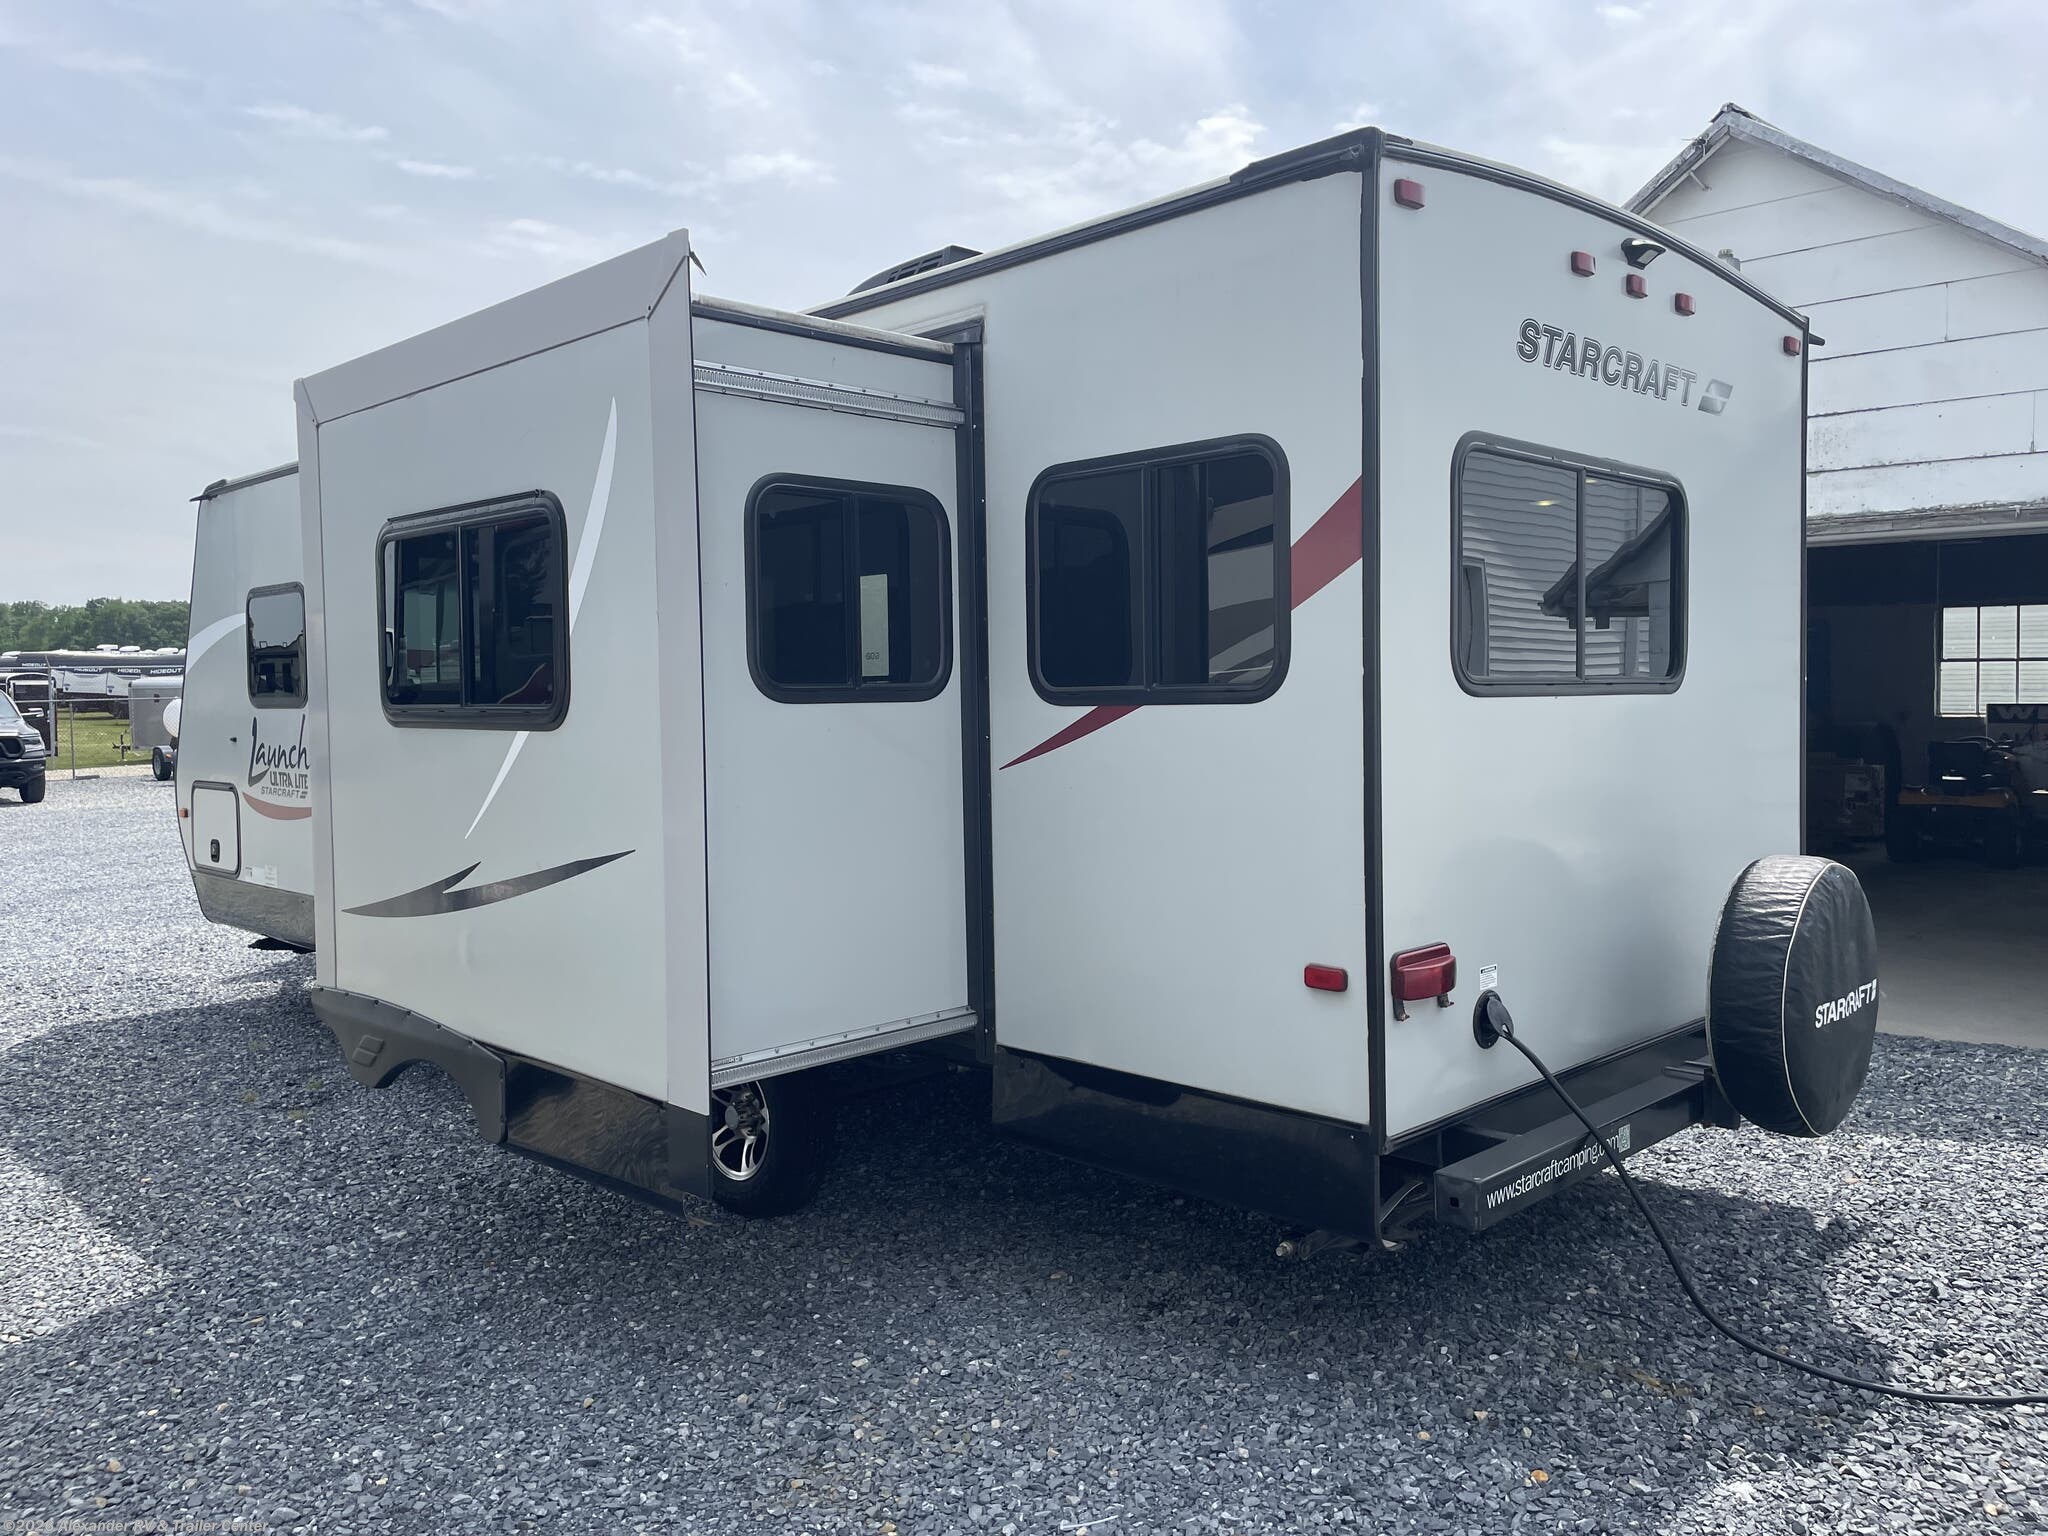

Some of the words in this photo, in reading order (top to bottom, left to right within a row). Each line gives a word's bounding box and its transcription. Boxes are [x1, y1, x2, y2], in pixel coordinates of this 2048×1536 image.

[1516, 318, 1697, 406] STARCRAFT
[248, 714, 310, 787] Launch
[269, 770, 294, 789] ULTRA
[295, 773, 309, 790] LITE
[261, 787, 300, 799] STARCRAFT
[1486, 1135, 1619, 1209] www.starcraftcamping.cm
